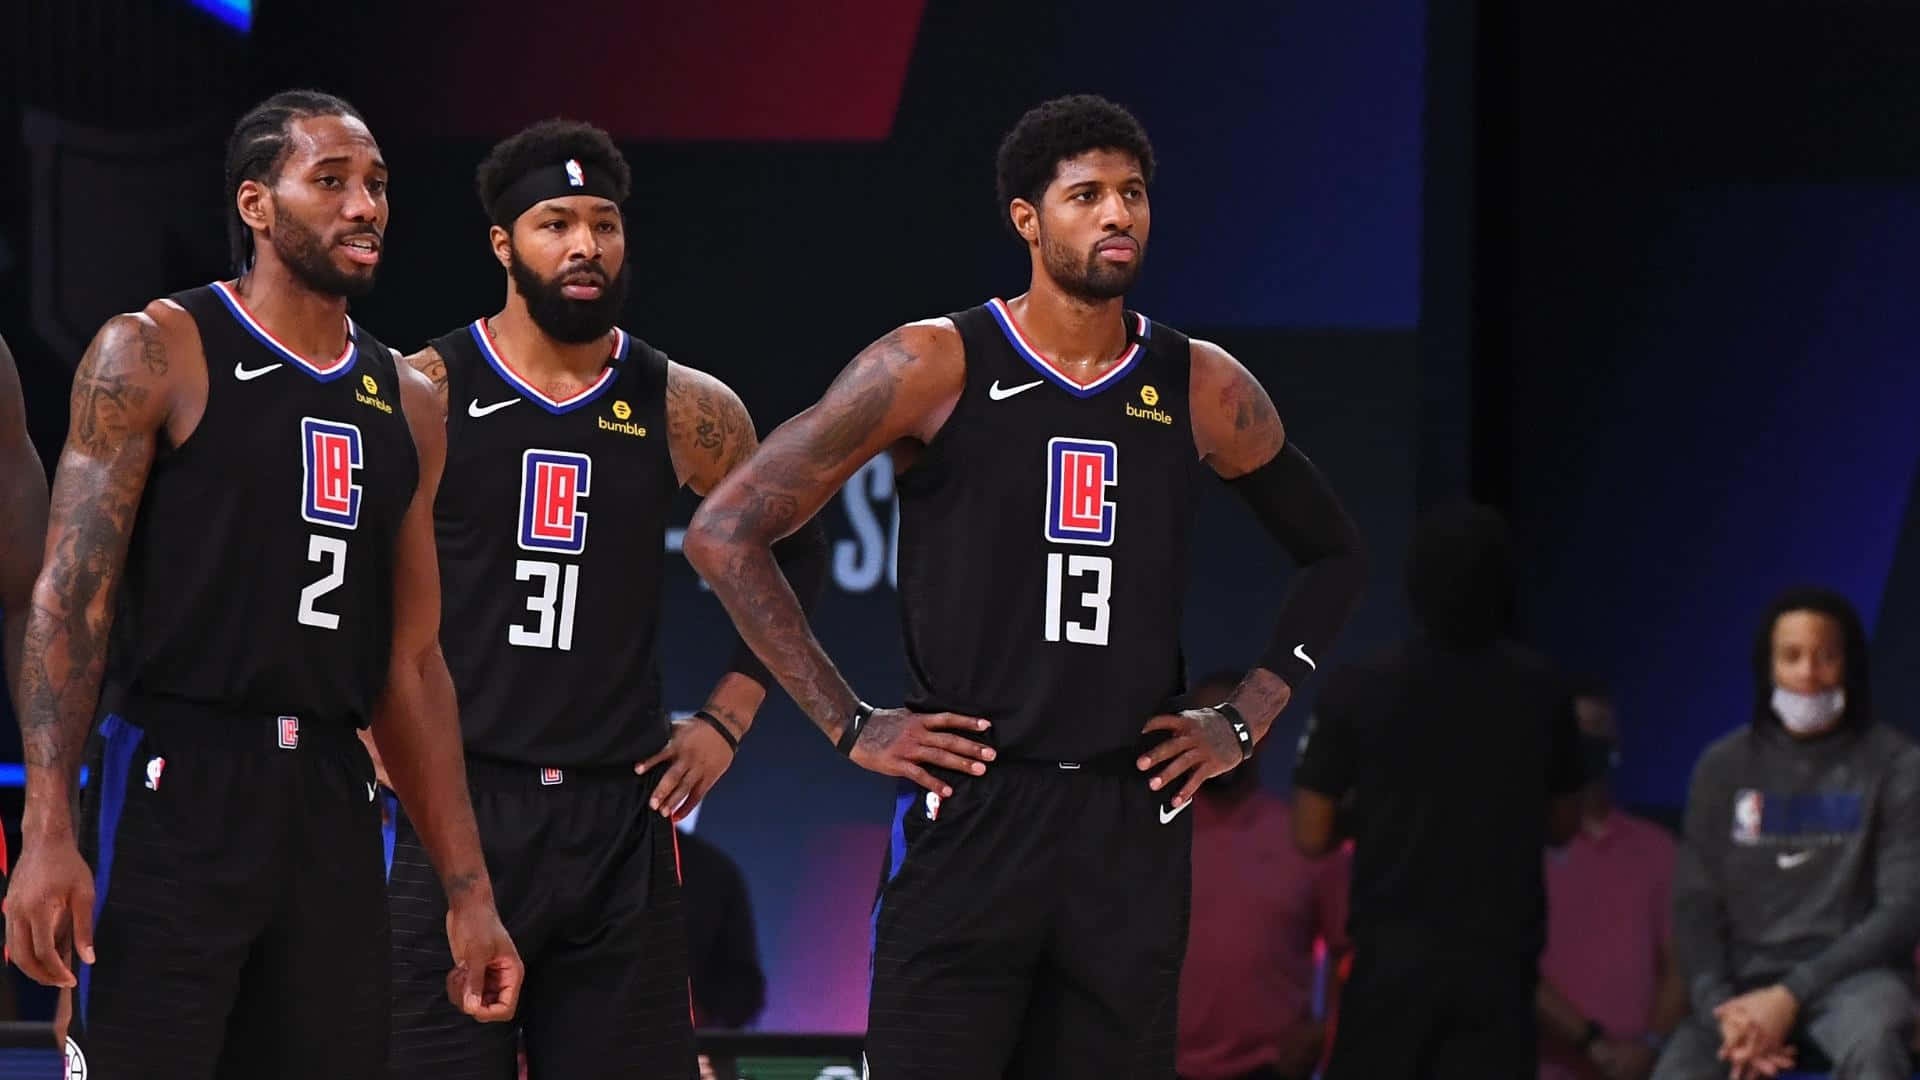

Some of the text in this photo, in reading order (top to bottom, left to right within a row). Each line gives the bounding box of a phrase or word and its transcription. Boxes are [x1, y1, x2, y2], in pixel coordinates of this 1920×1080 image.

[356, 389, 392, 414] bumble
[598, 416, 647, 437] bumble
[1126, 403, 1173, 425] bumble
[298, 534, 348, 630] 2
[509, 560, 580, 651] 31
[1045, 553, 1113, 646] 13
